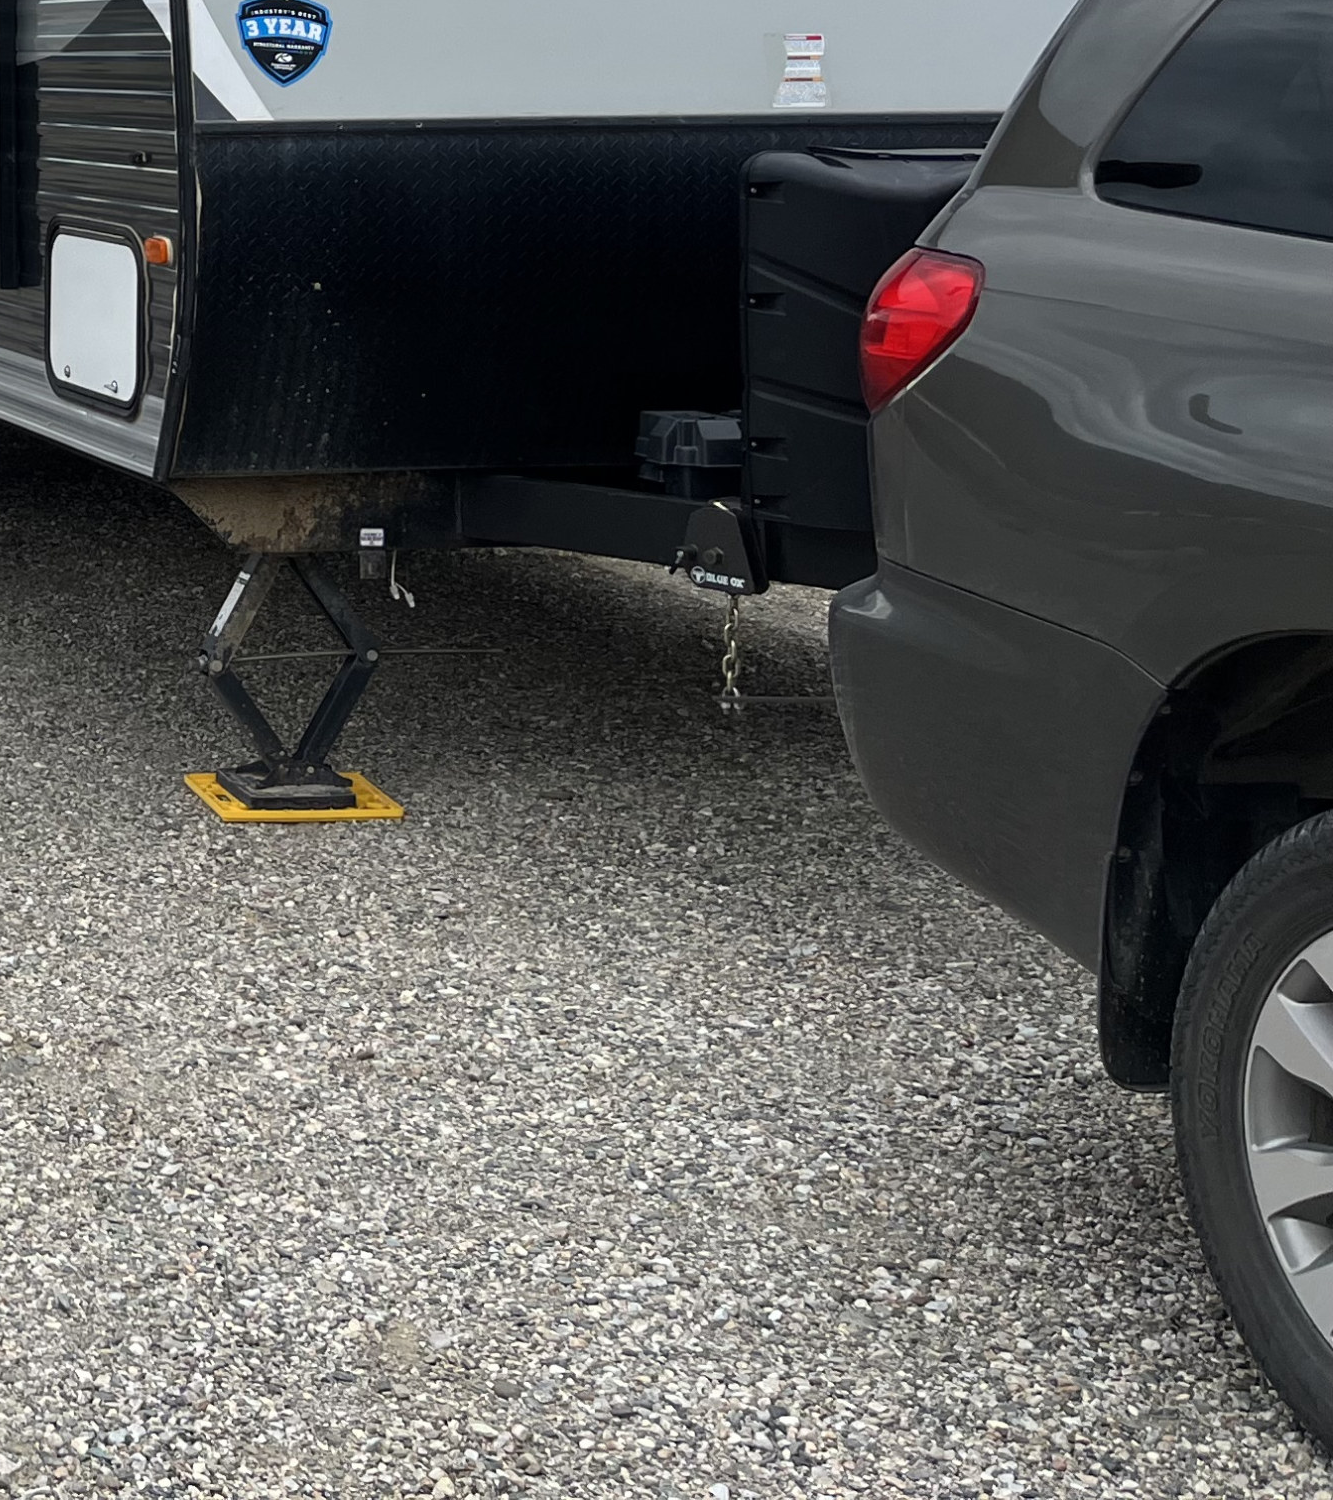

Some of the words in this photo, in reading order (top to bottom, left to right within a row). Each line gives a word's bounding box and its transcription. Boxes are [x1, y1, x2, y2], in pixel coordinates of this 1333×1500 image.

[245, 19, 259, 37] 3
[263, 18, 323, 41] YEAR
[706, 572, 729, 586] BLUE
[730, 576, 745, 589] OX
[1197, 931, 1266, 1139] YOKOHAMA
